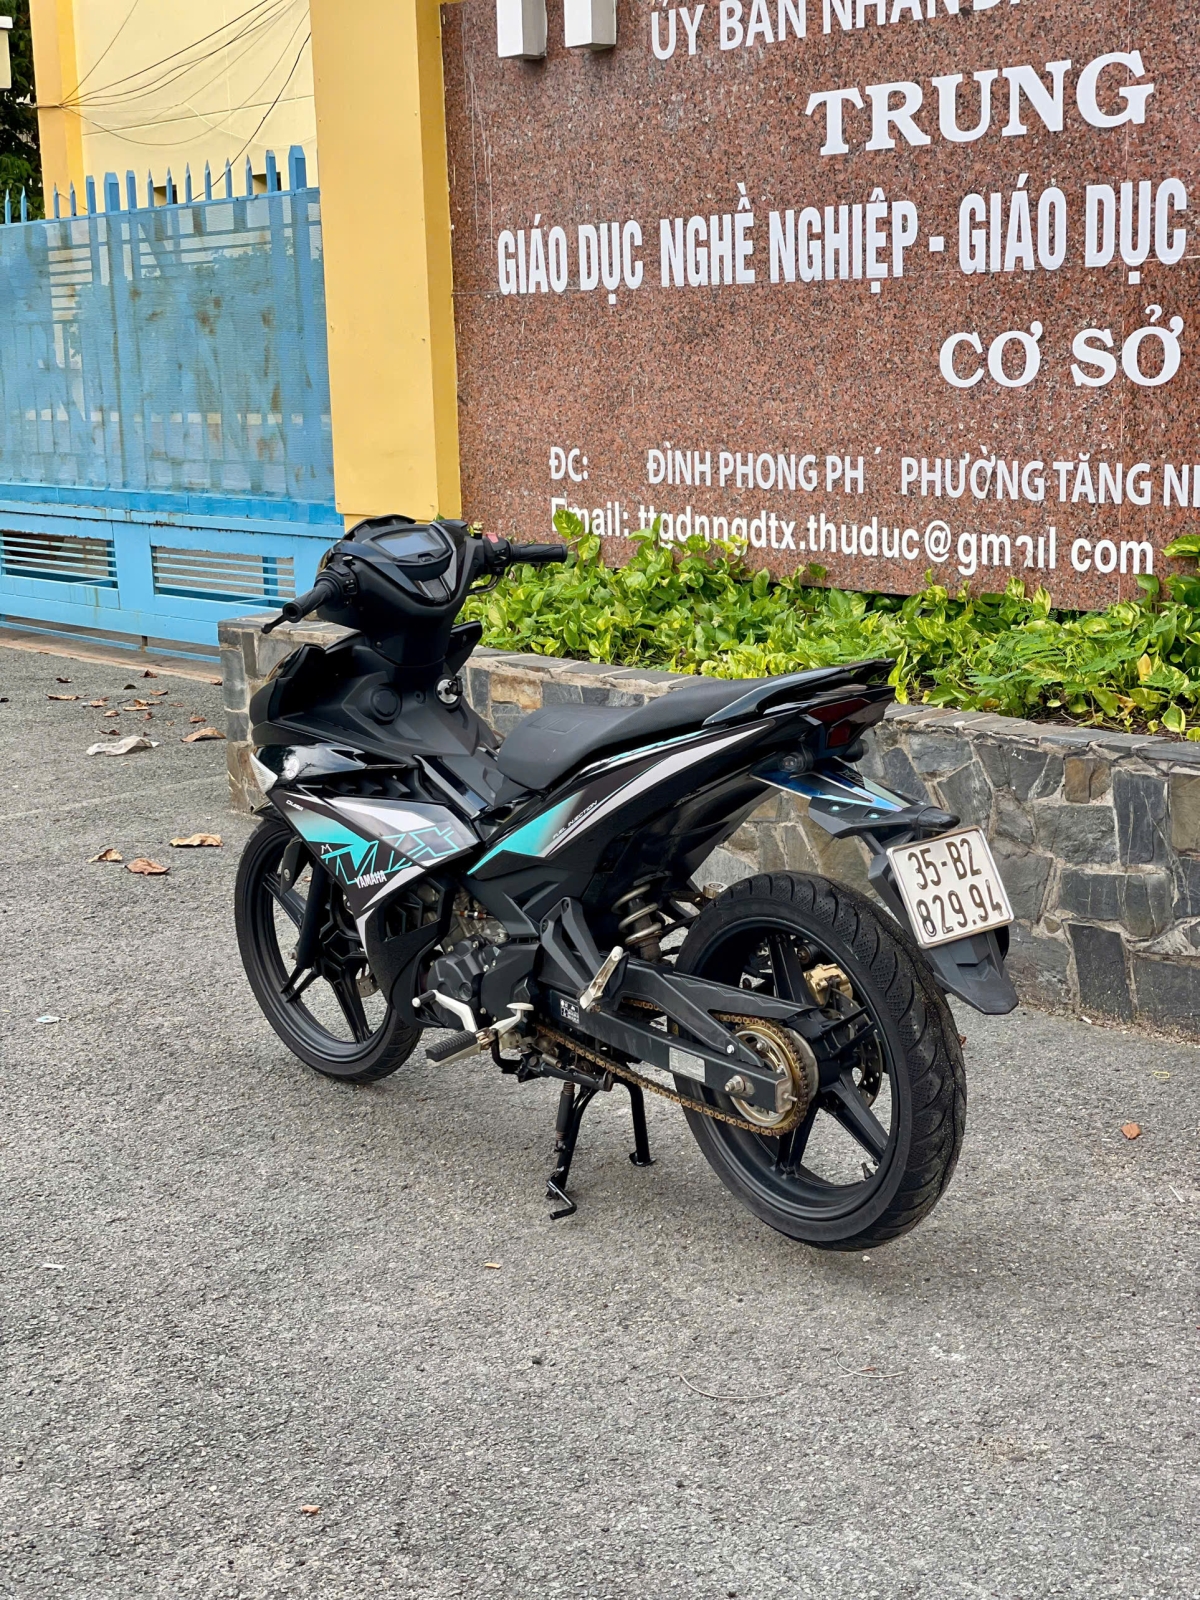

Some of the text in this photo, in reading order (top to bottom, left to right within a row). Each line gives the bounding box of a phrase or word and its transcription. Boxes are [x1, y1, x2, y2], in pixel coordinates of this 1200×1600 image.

[719, 0, 807, 51] BAN
[805, 50, 1155, 156] TRUNG
[497, 173, 1188, 305] GIÁO DỤC NGHỀ NGHIỆP - GIÁO DỤC
[939, 304, 1184, 388] CƠ SỞ
[549, 446, 589, 482] ĐC:
[646, 441, 712, 487] ĐÌNH
[719, 452, 818, 492] PHONG
[901, 445, 1045, 502] PHƯỜNG
[1052, 452, 1152, 506] TĂNG
[1070, 537, 1154, 575] com
[354, 869, 388, 889] YAMAHA
[907, 837, 983, 890] 35-B2
[916, 879, 1004, 938] 829.94
